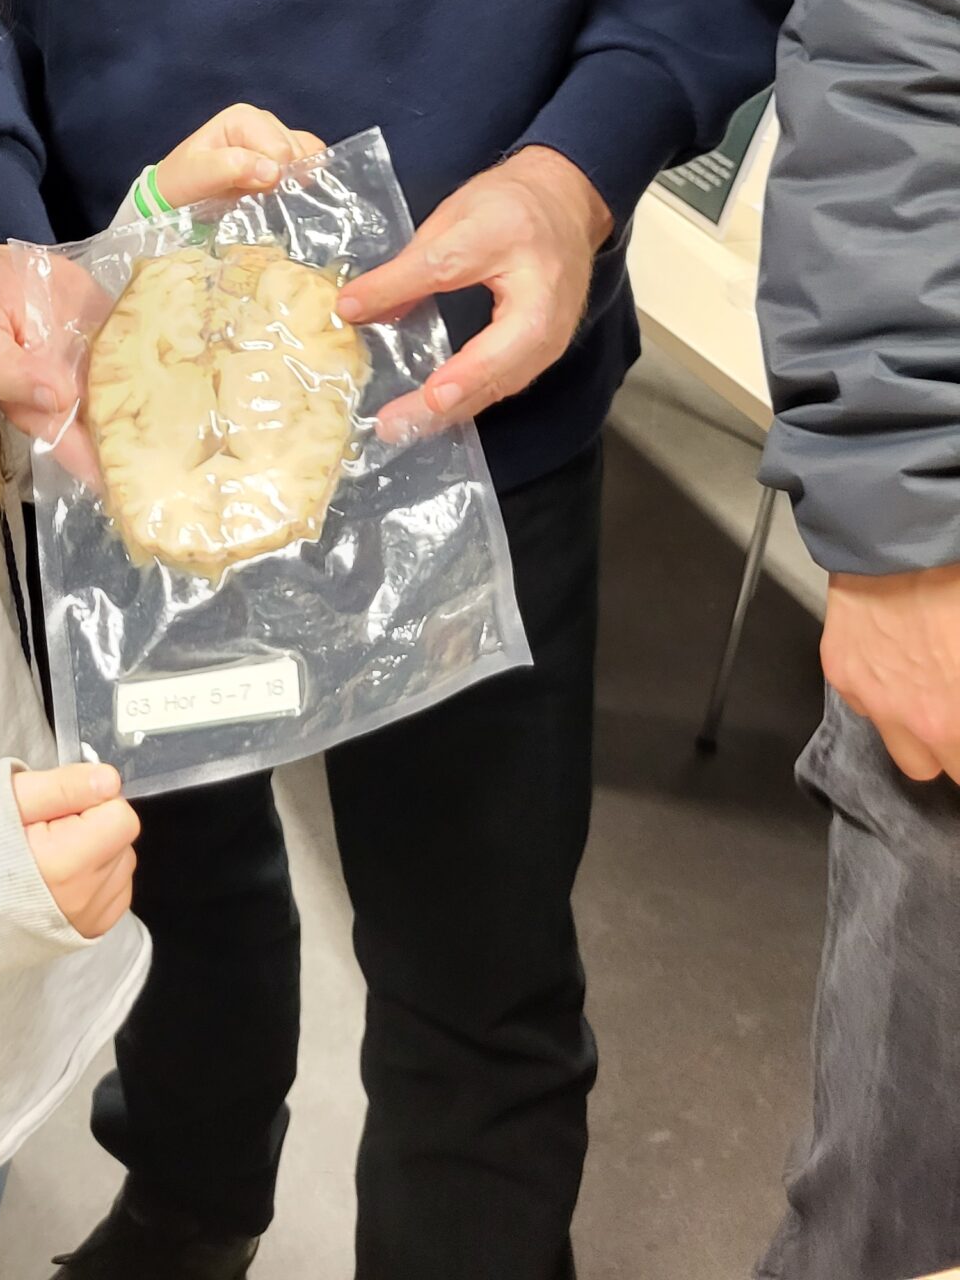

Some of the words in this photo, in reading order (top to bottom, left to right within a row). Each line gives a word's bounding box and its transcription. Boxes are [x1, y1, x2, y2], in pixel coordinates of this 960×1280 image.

[164, 693, 196, 712] Hor
[210, 683, 252, 705] 5-7
[265, 678, 285, 696] 18
